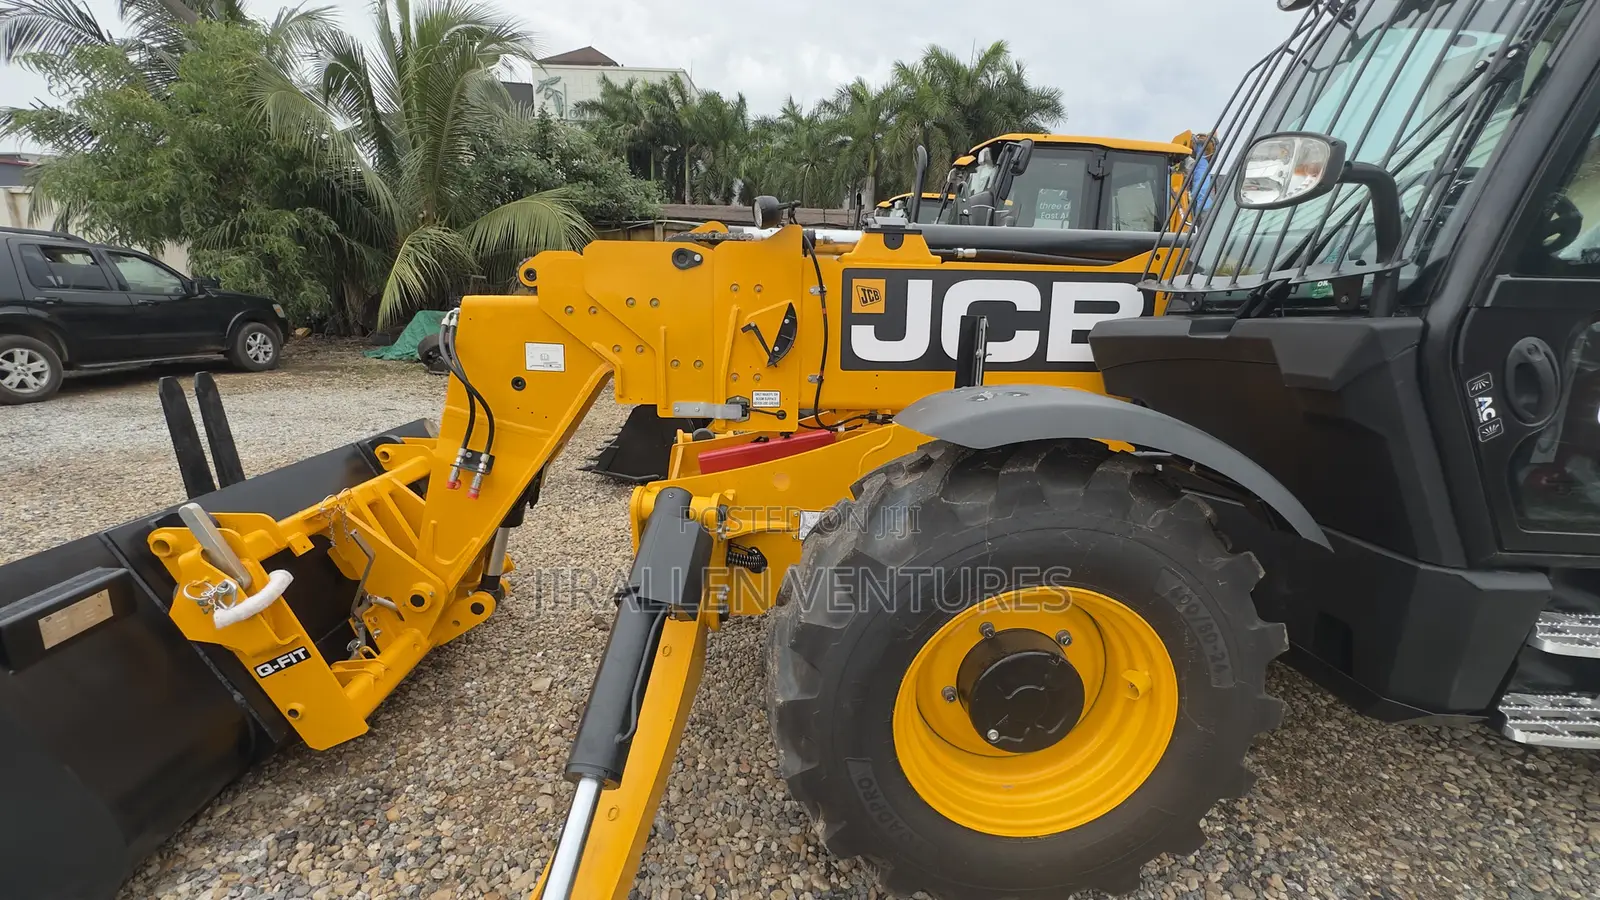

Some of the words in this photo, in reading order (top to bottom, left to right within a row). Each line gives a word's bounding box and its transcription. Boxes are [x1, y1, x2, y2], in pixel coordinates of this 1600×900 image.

[858, 286, 881, 304] JCB
[851, 279, 1144, 362] JCB
[1478, 397, 1496, 421] AC
